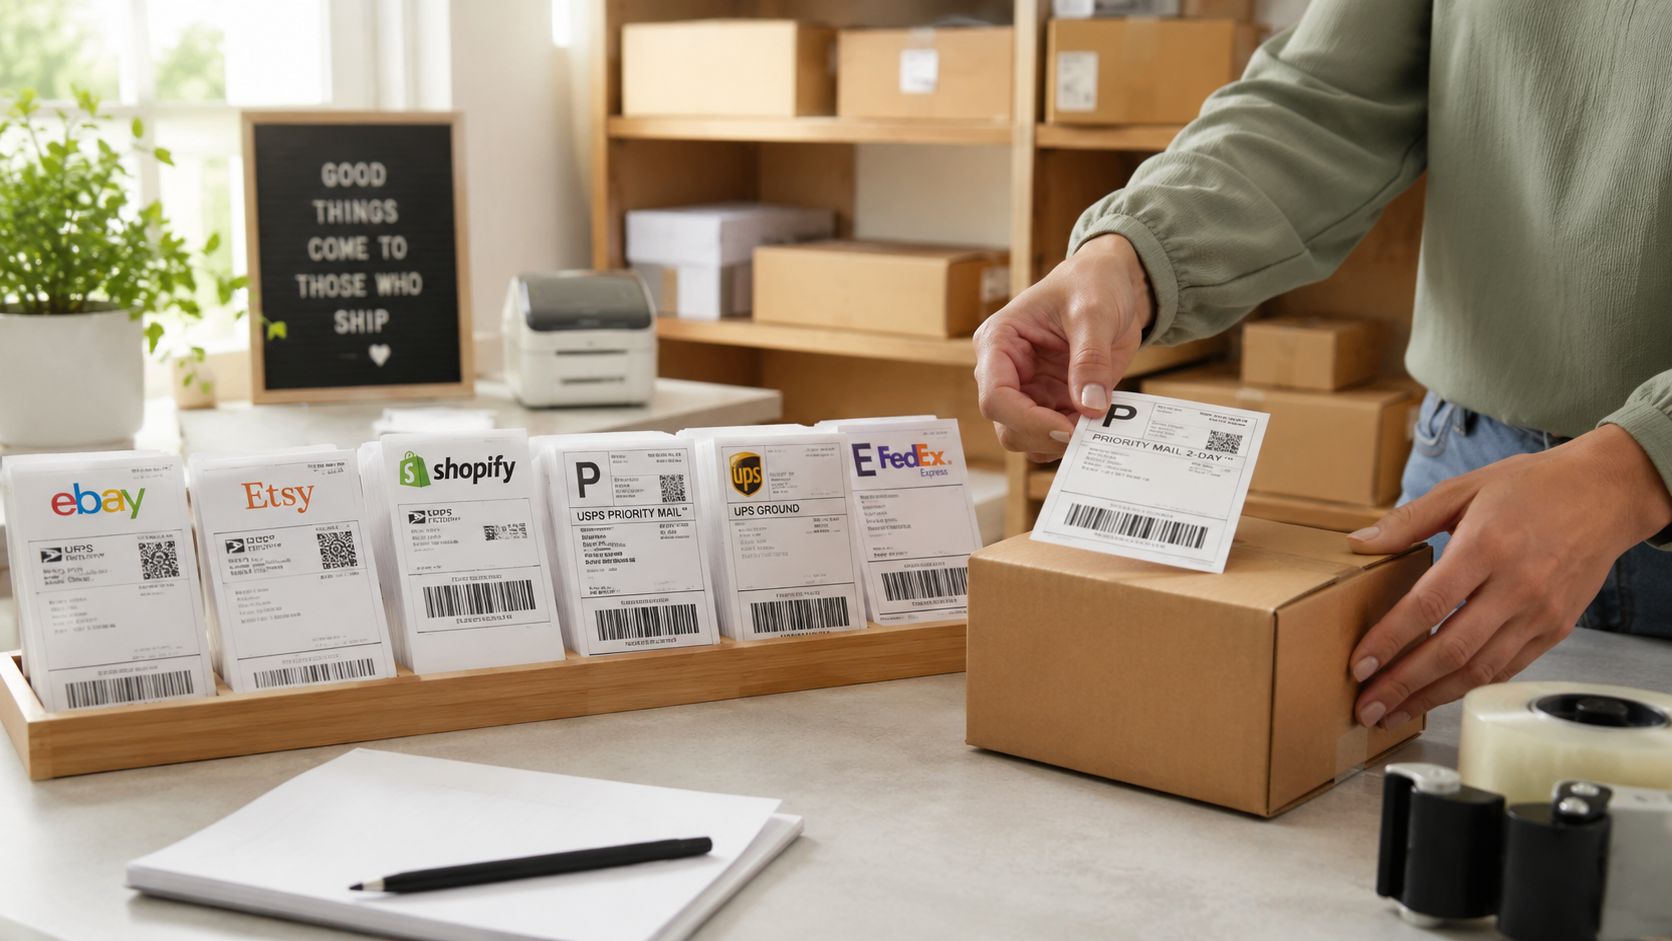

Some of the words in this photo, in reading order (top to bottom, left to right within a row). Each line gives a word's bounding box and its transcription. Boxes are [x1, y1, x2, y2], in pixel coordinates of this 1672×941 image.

[321, 162, 387, 187] GOOD
[312, 199, 398, 225] THINGS
[308, 236, 369, 261] COME
[378, 235, 407, 260] TO
[296, 273, 367, 298] THOSE
[375, 272, 423, 296] WHO
[334, 309, 389, 334] SHIP
[1102, 404, 1138, 428] P
[851, 443, 877, 477] E
[877, 442, 946, 469] FedEx
[1092, 433, 1150, 449] PRIORITY
[1152, 443, 1182, 456] MAIL
[1186, 449, 1223, 462] 2-DAY
[434, 455, 516, 484] shopify
[575, 461, 601, 498] P
[733, 466, 762, 491] ups
[920, 468, 949, 478] Express
[51, 483, 145, 519] ebay
[241, 481, 314, 513] Etsy
[734, 505, 755, 516] UPS
[757, 503, 800, 515] GROUND
[577, 510, 605, 522] USPS
[608, 508, 655, 520] PRIORITY
[657, 507, 682, 518] MAIL
